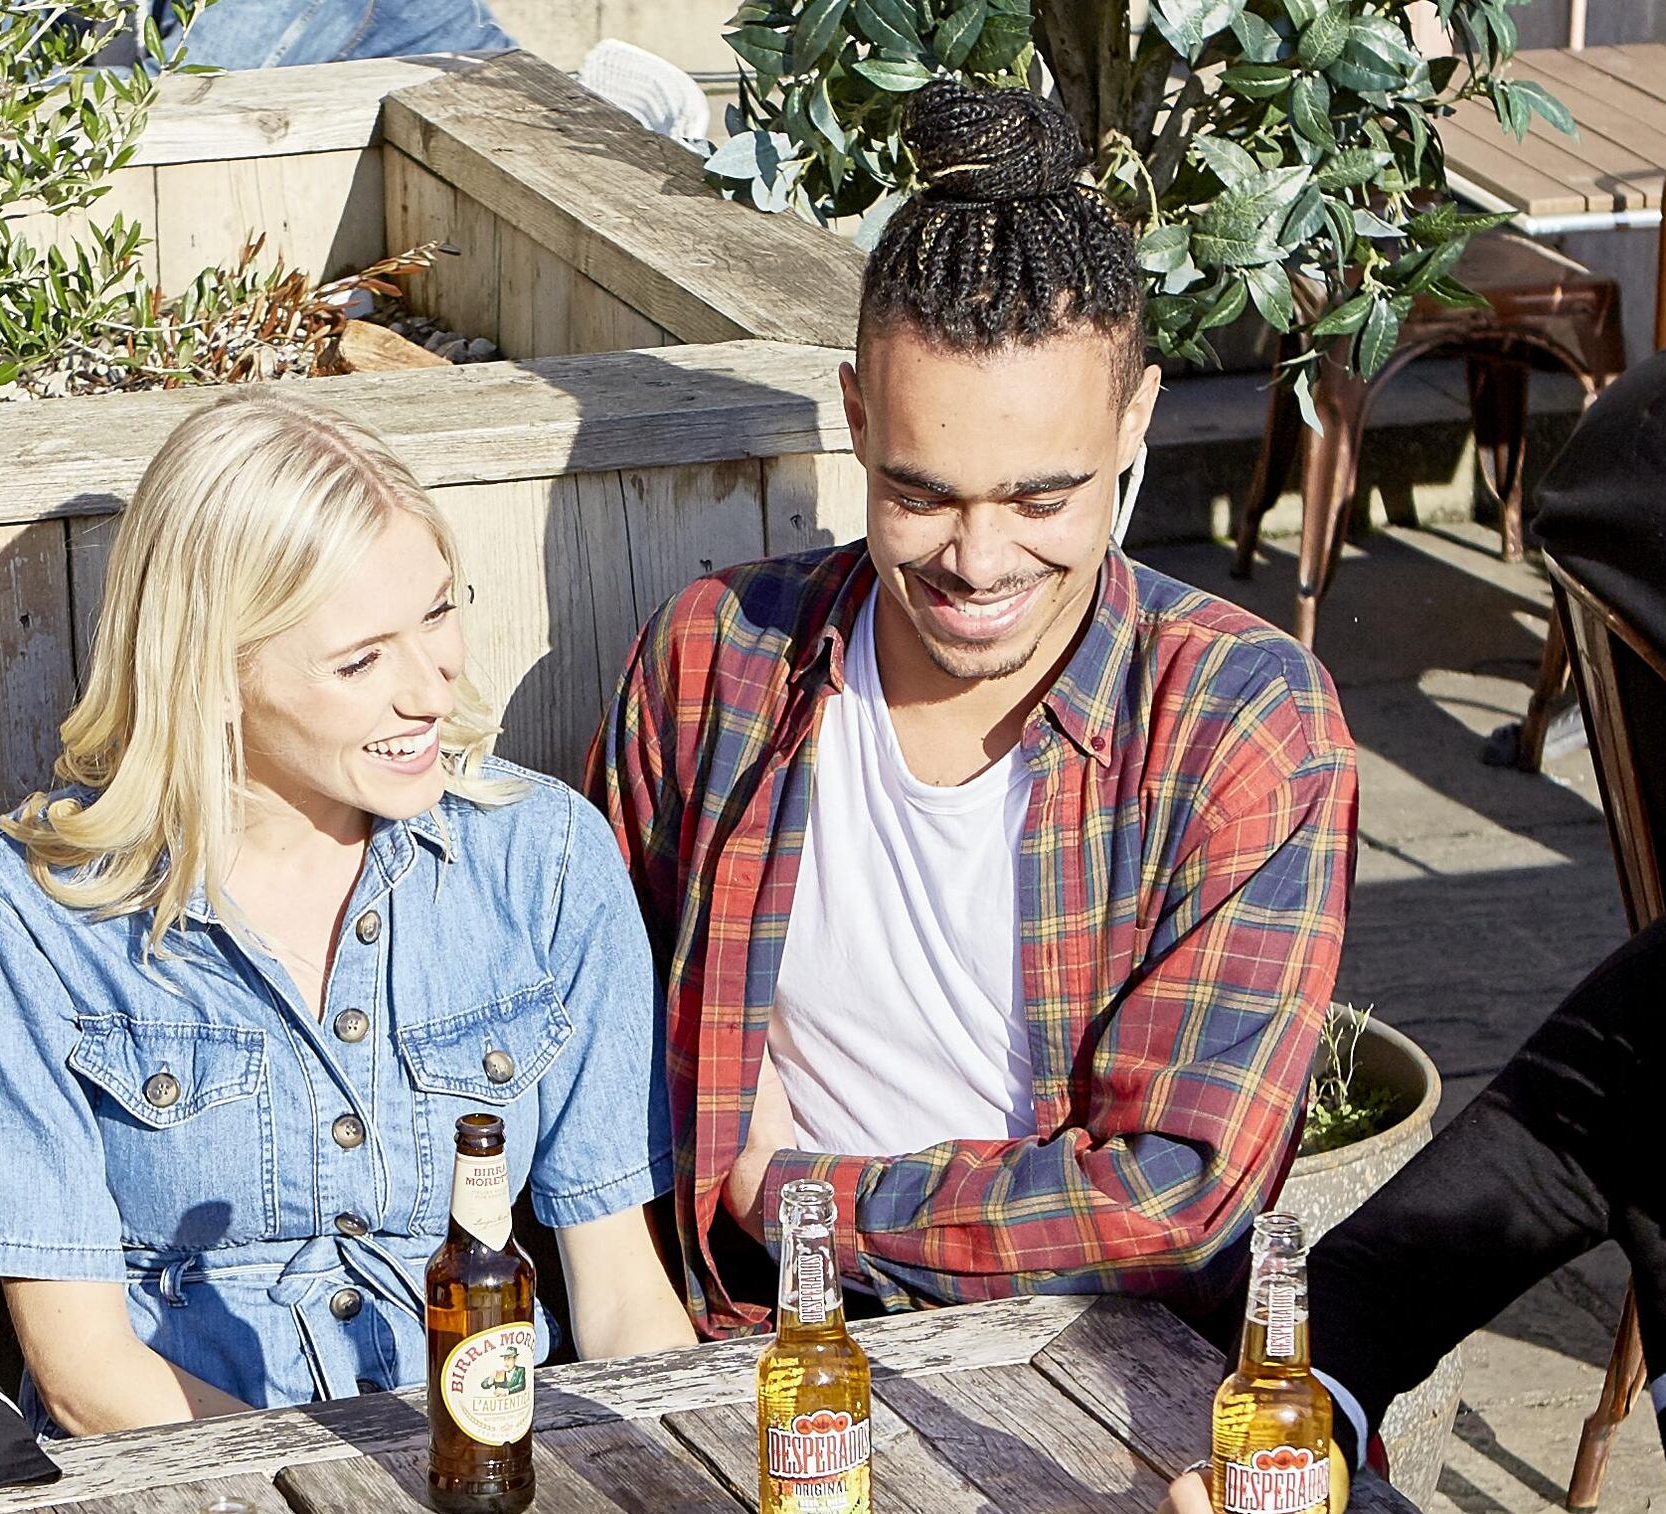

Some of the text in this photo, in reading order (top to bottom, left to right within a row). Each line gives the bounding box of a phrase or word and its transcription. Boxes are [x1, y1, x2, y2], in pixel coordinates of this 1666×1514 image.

[800, 1255, 823, 1321] DESPERADOS
[1271, 1288, 1294, 1354] DESPERADOS
[451, 1339, 497, 1394] BIRRA
[769, 1422, 870, 1475] DESPERADOS
[795, 1481, 849, 1497] ORIGINAL
[1227, 1461, 1329, 1511] DESPERADOS
